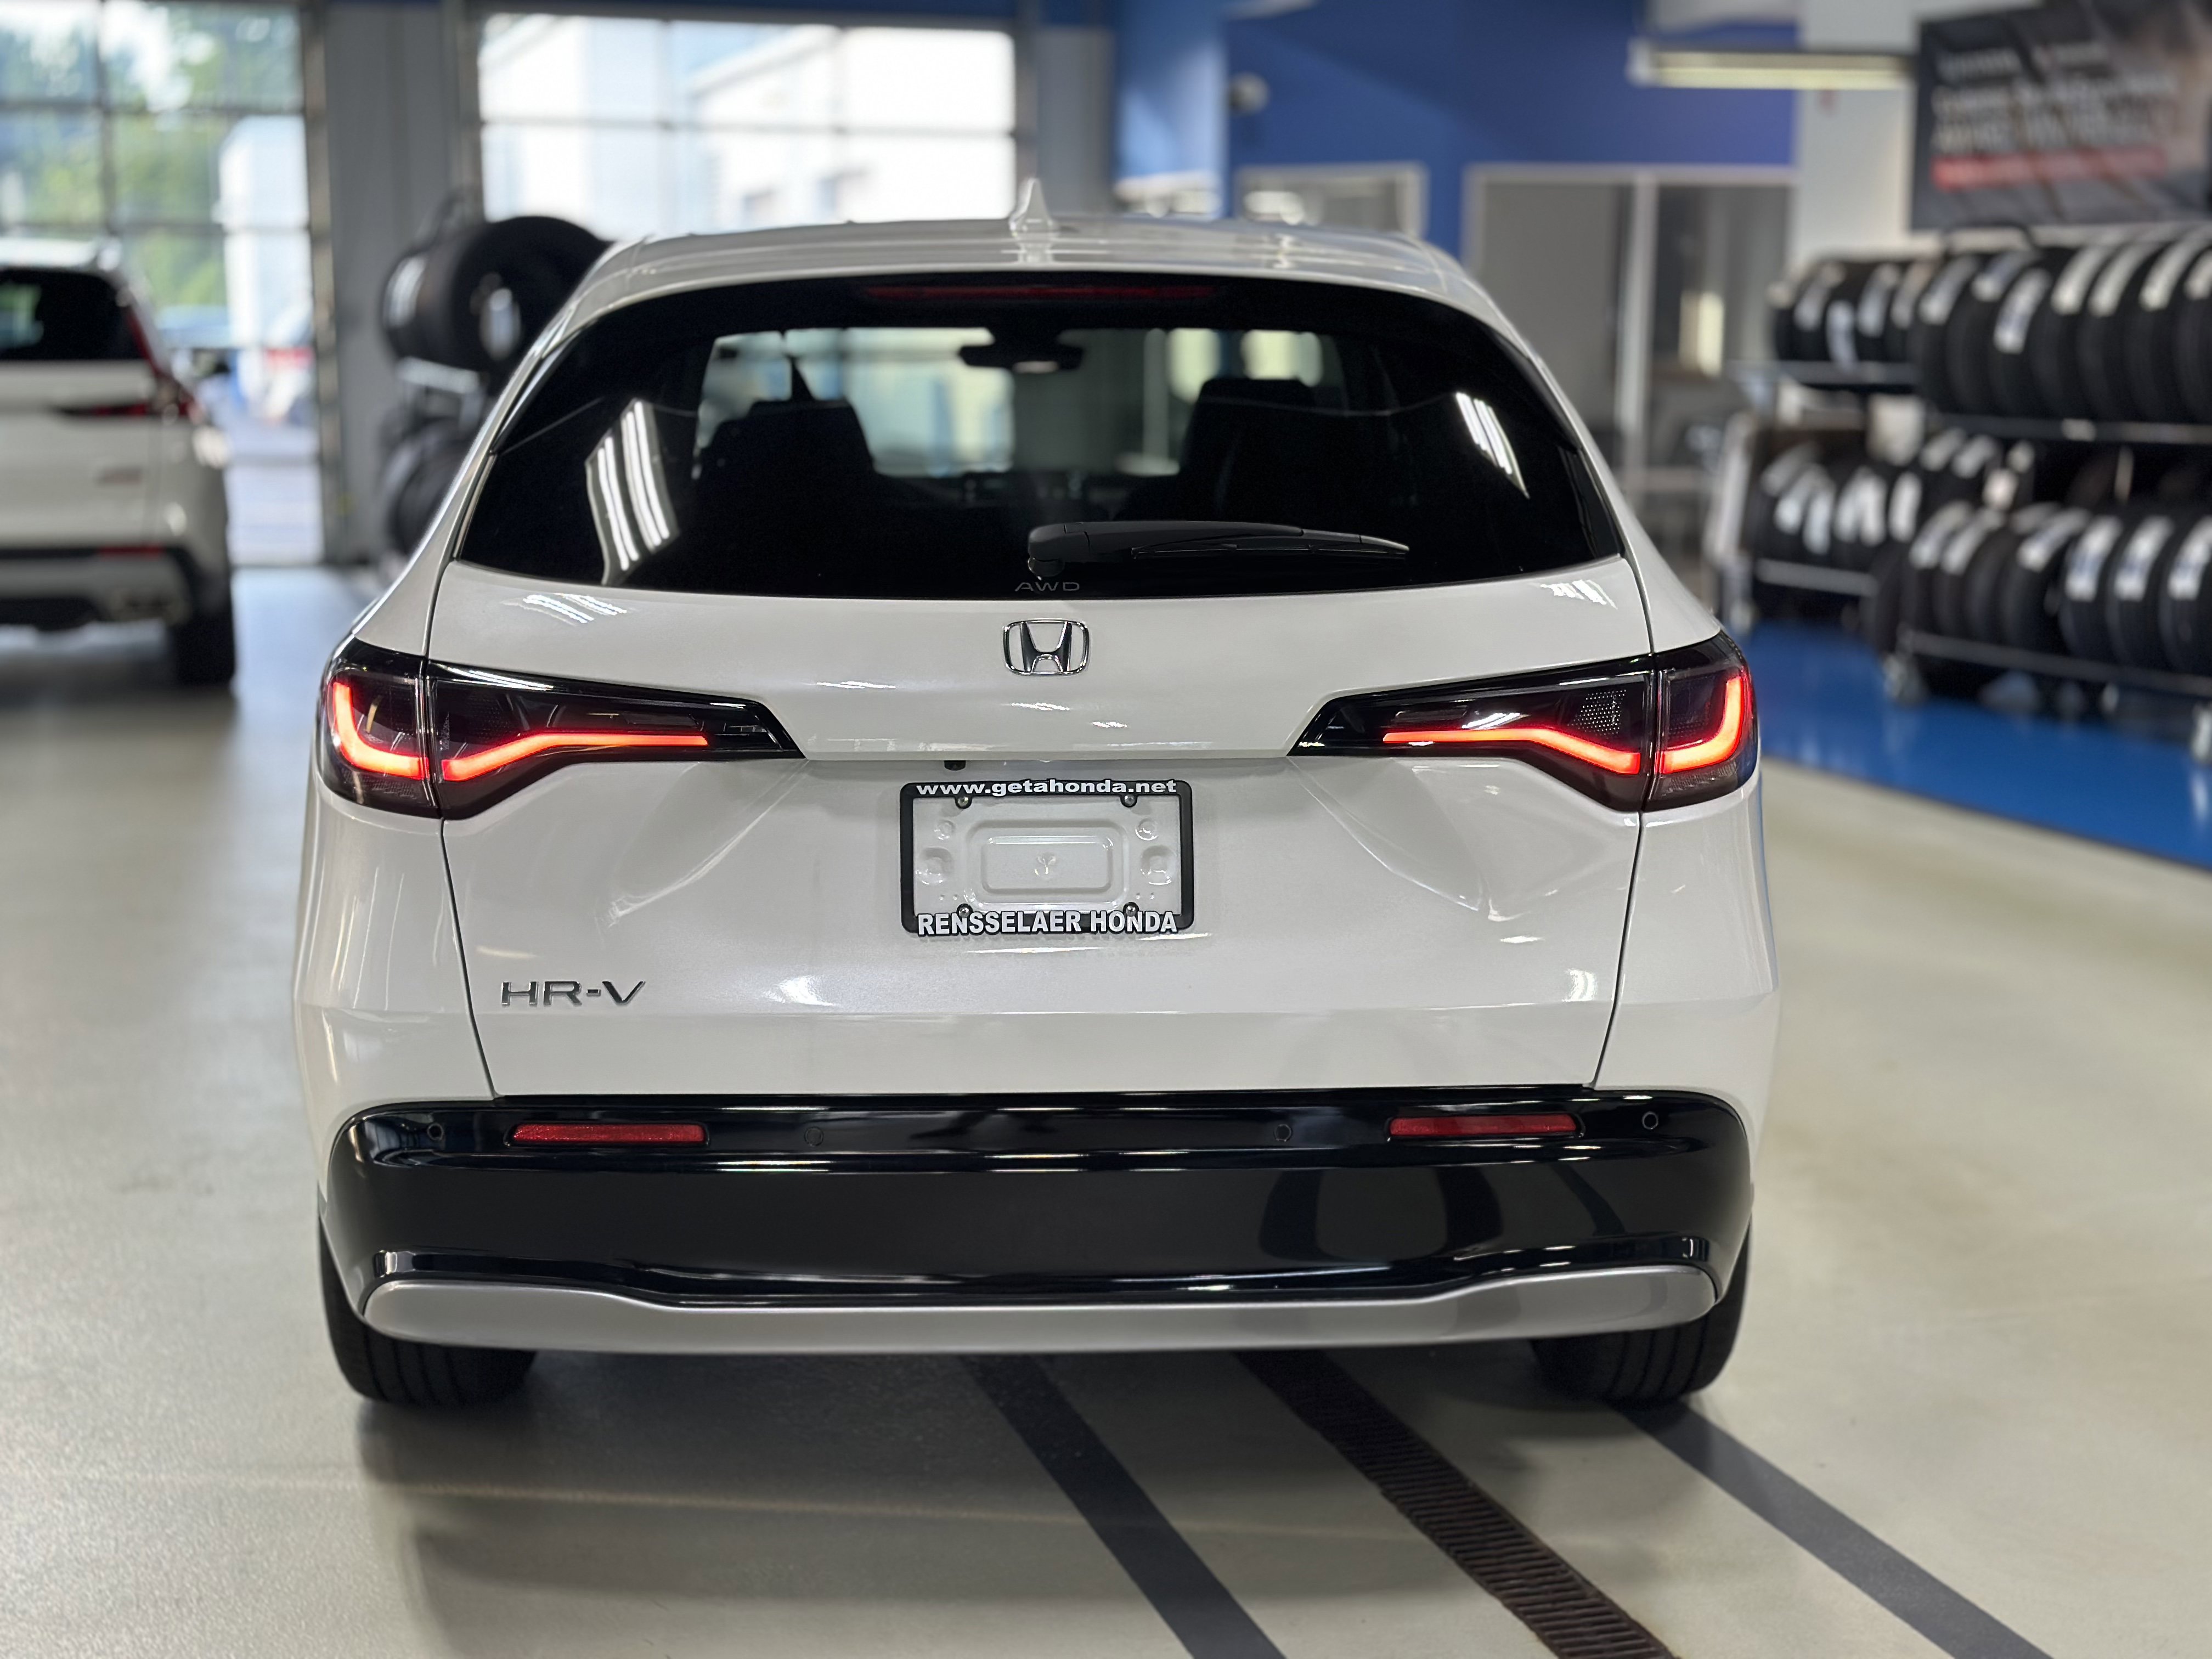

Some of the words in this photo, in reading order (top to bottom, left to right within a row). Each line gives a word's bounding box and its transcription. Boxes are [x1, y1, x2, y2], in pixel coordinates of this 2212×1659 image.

[1015, 582, 1080, 591] AWD
[916, 780, 1176, 797] www.getahonda.net
[917, 912, 1081, 935] RENSSELAER
[1091, 911, 1177, 933] HONDA
[501, 980, 646, 1006] HR-V
